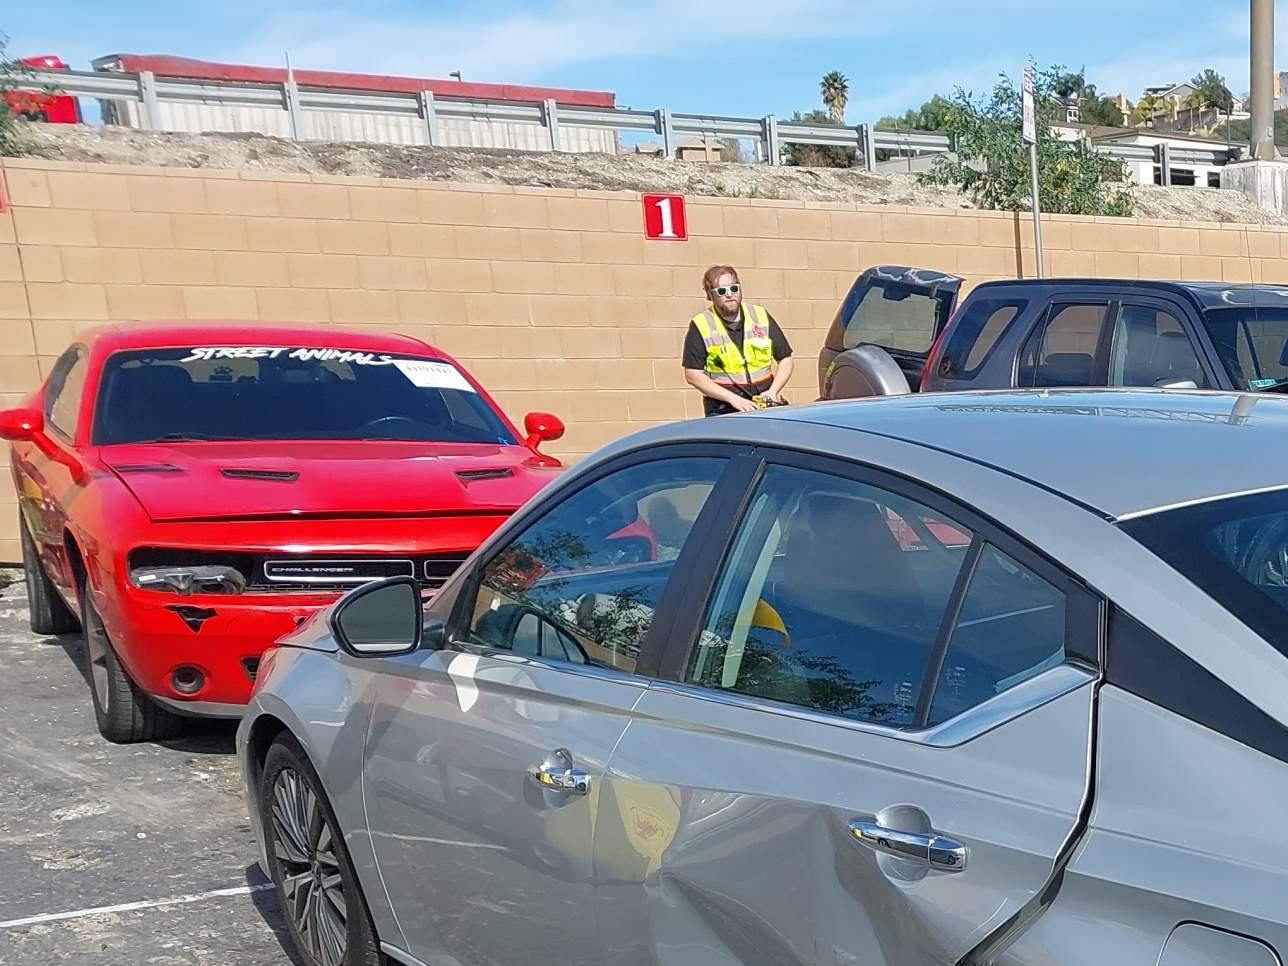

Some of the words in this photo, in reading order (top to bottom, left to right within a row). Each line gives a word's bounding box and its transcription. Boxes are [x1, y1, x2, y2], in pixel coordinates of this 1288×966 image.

[655, 198, 679, 237] 1
[180, 347, 289, 362] STREET
[289, 348, 394, 366] ANIMALS
